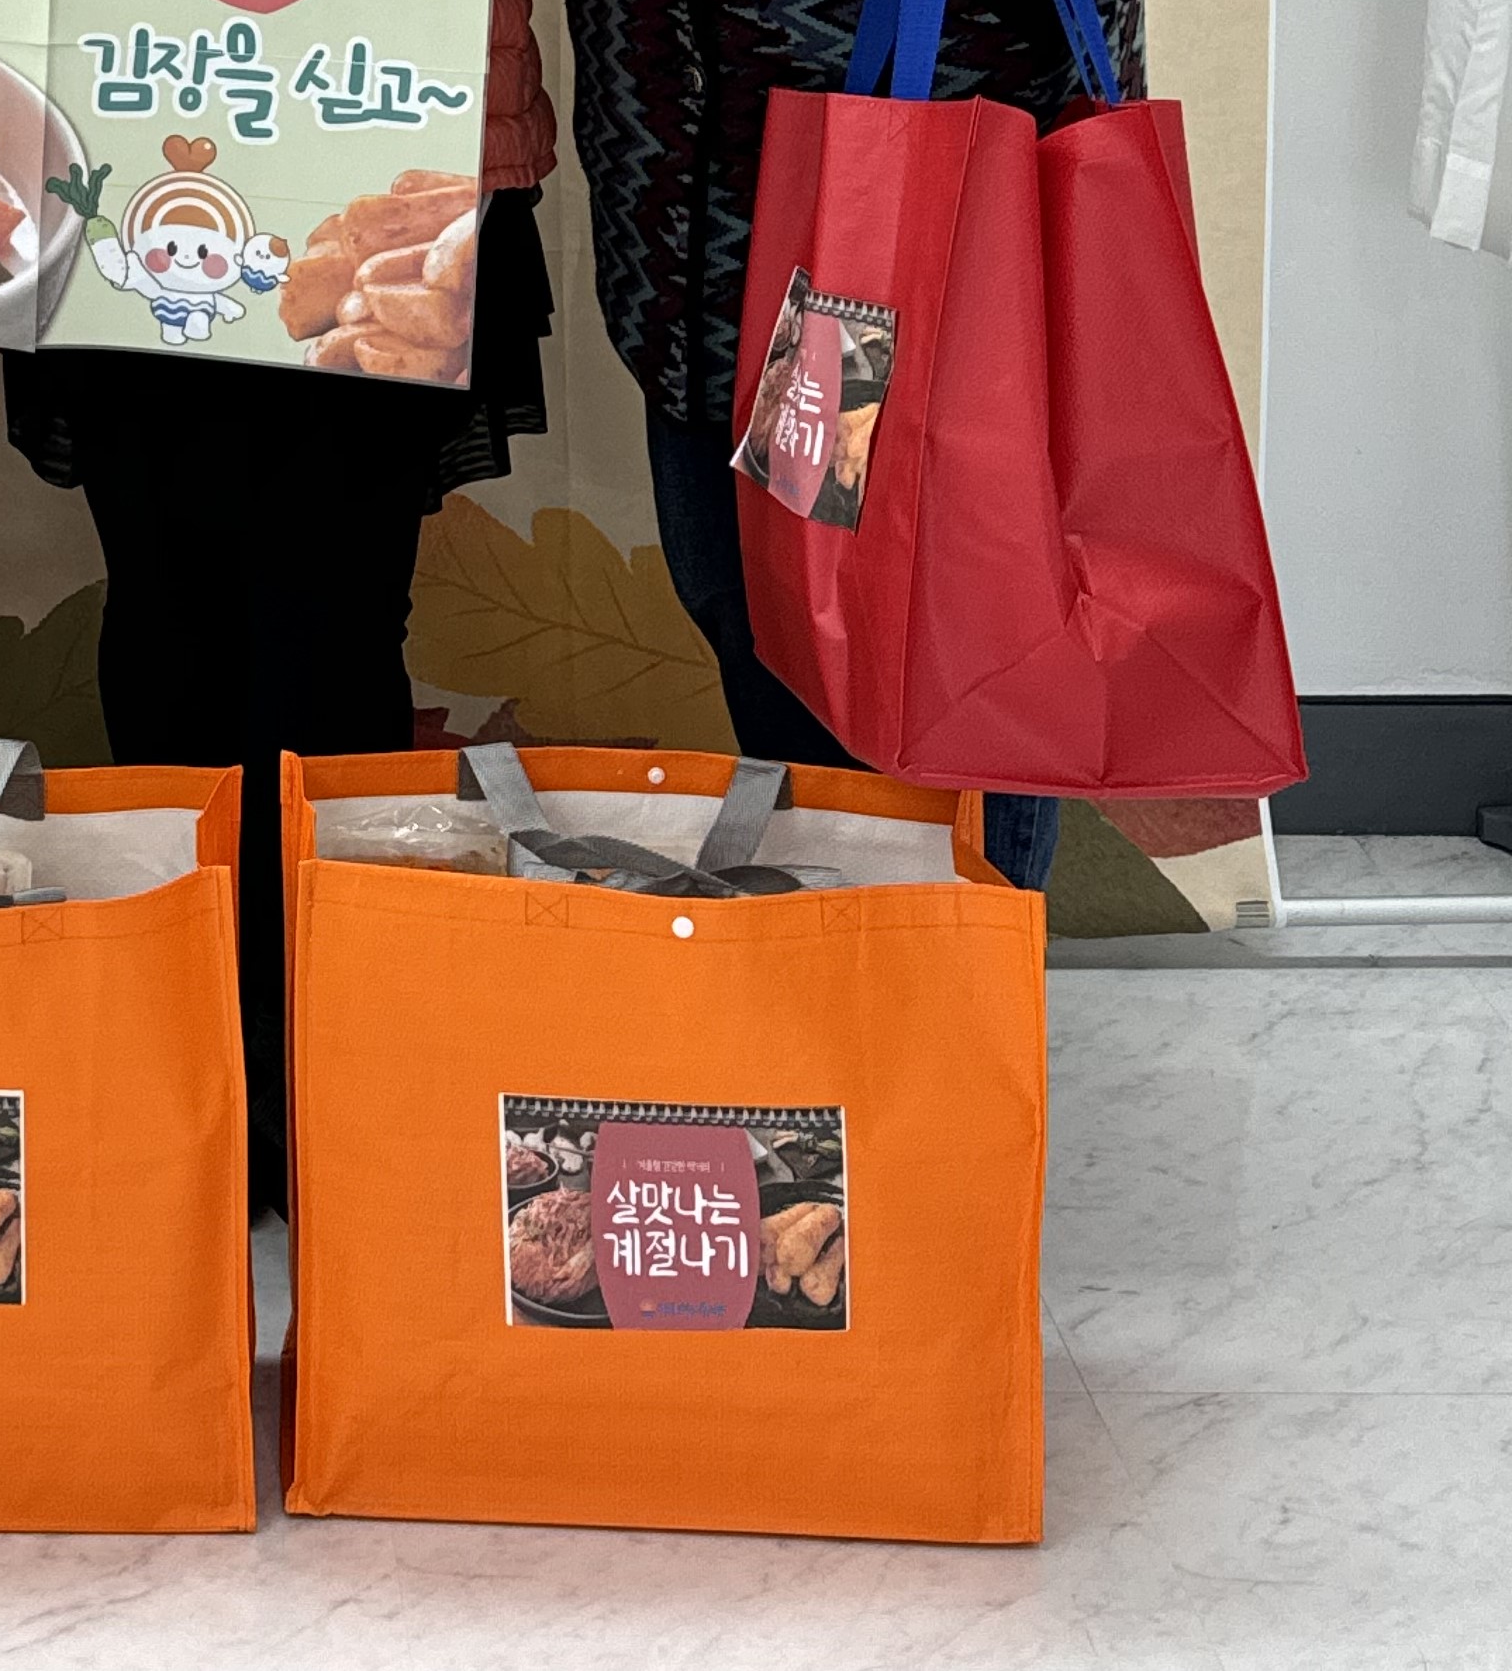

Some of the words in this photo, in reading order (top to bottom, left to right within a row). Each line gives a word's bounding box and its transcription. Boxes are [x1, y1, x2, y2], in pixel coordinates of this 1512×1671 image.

[86, 22, 276, 139] 김장을
[293, 41, 468, 126] 싣고~
[605, 1178, 742, 1226] 살맛나는
[602, 1226, 750, 1279] 계절나기
